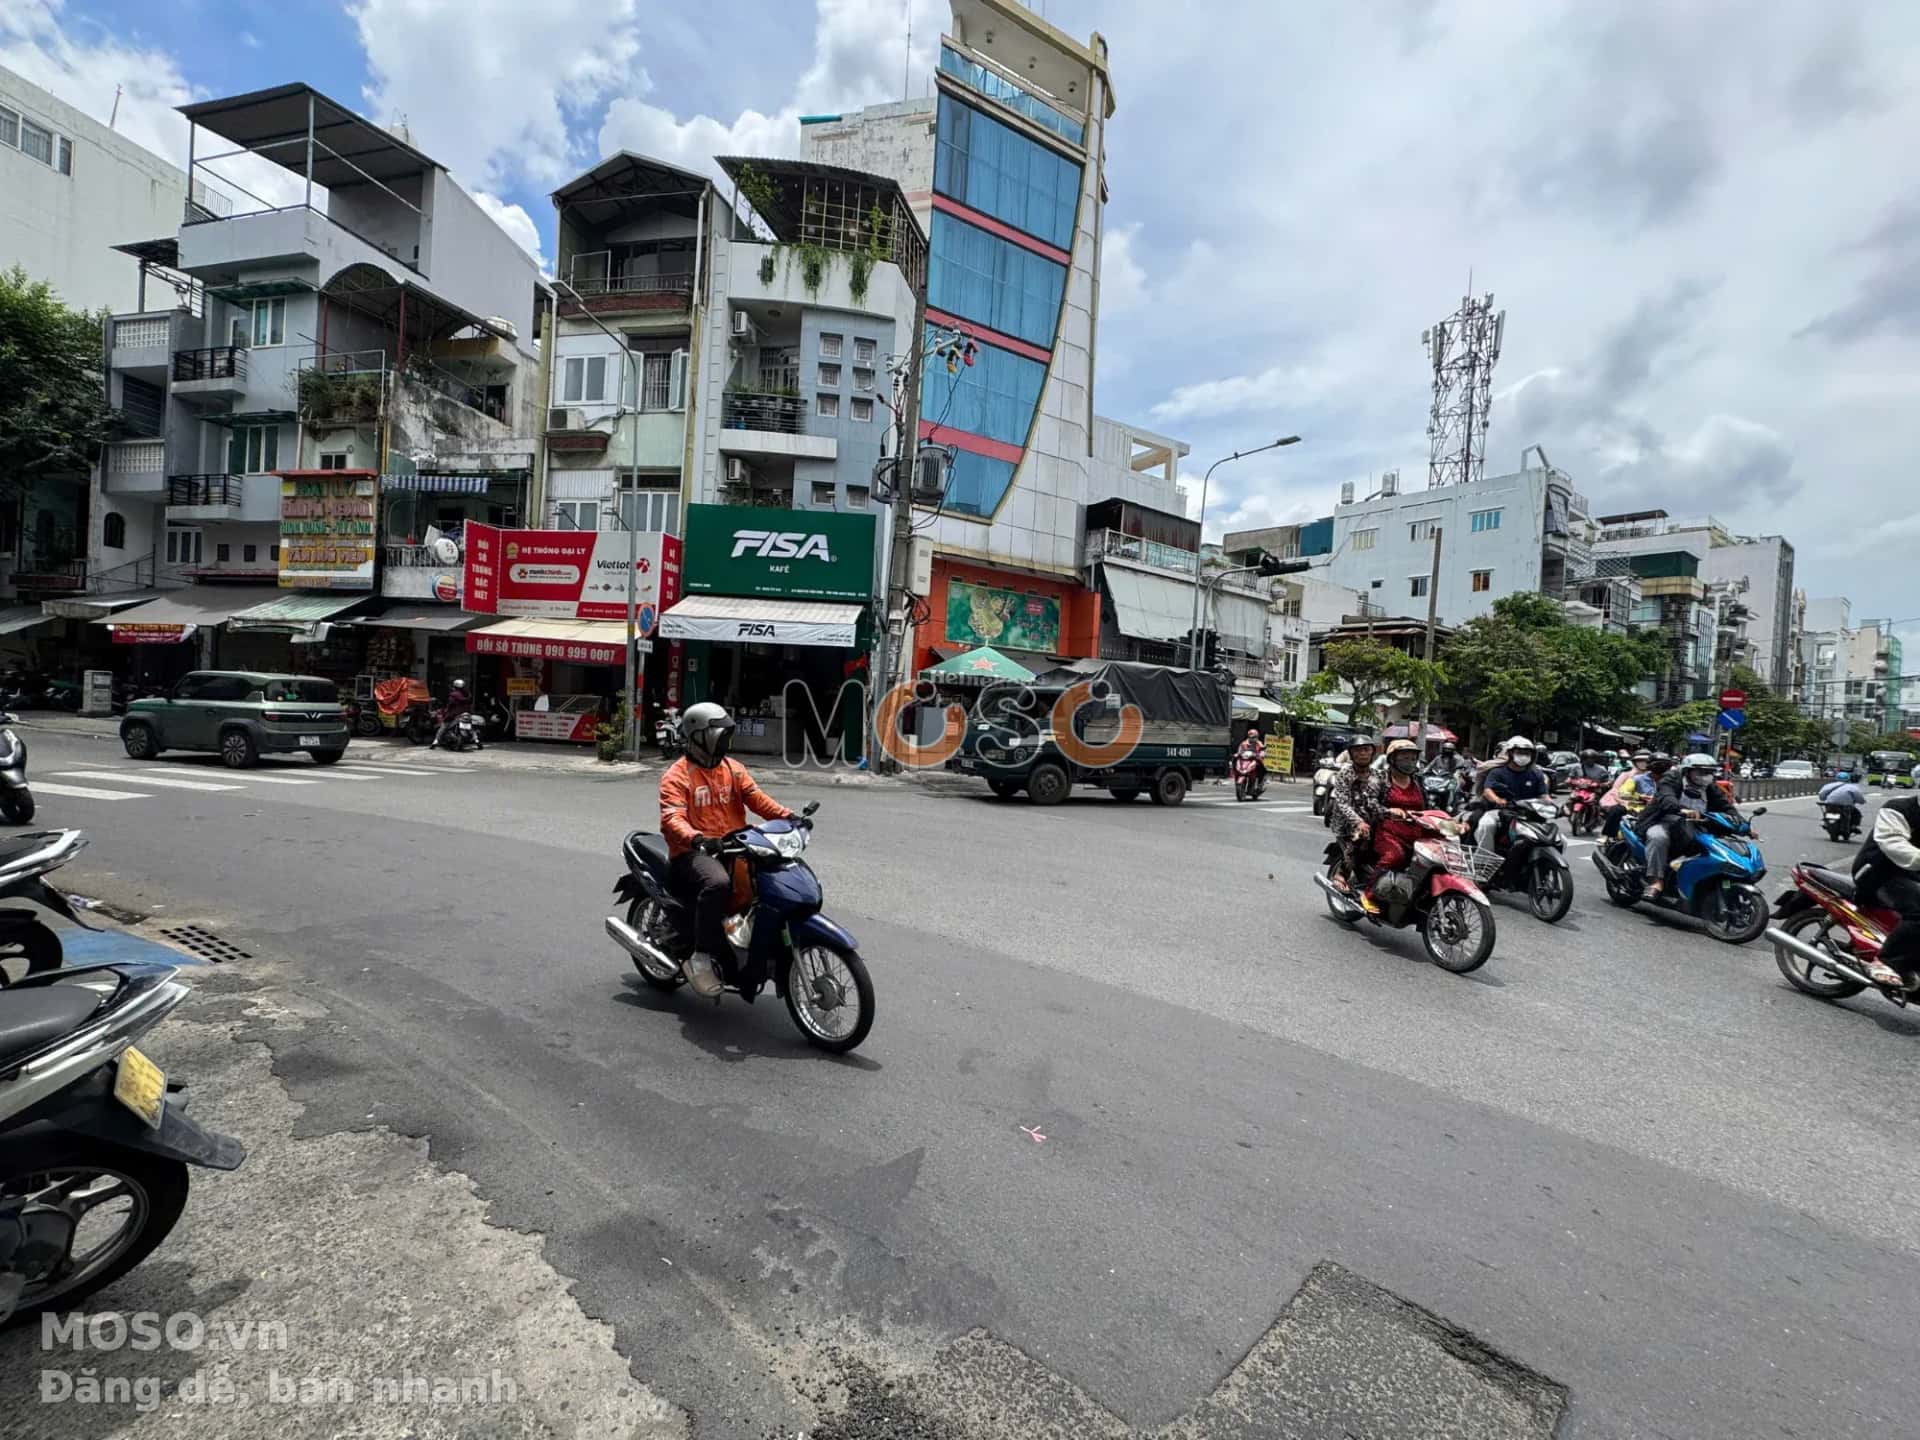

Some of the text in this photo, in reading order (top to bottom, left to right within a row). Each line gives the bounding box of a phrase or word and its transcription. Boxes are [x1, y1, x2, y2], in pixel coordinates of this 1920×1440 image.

[730, 529, 830, 563] FISA
[596, 559, 630, 570] Vietlot
[737, 623, 776, 638] FISA
[567, 646, 587, 660] 999
